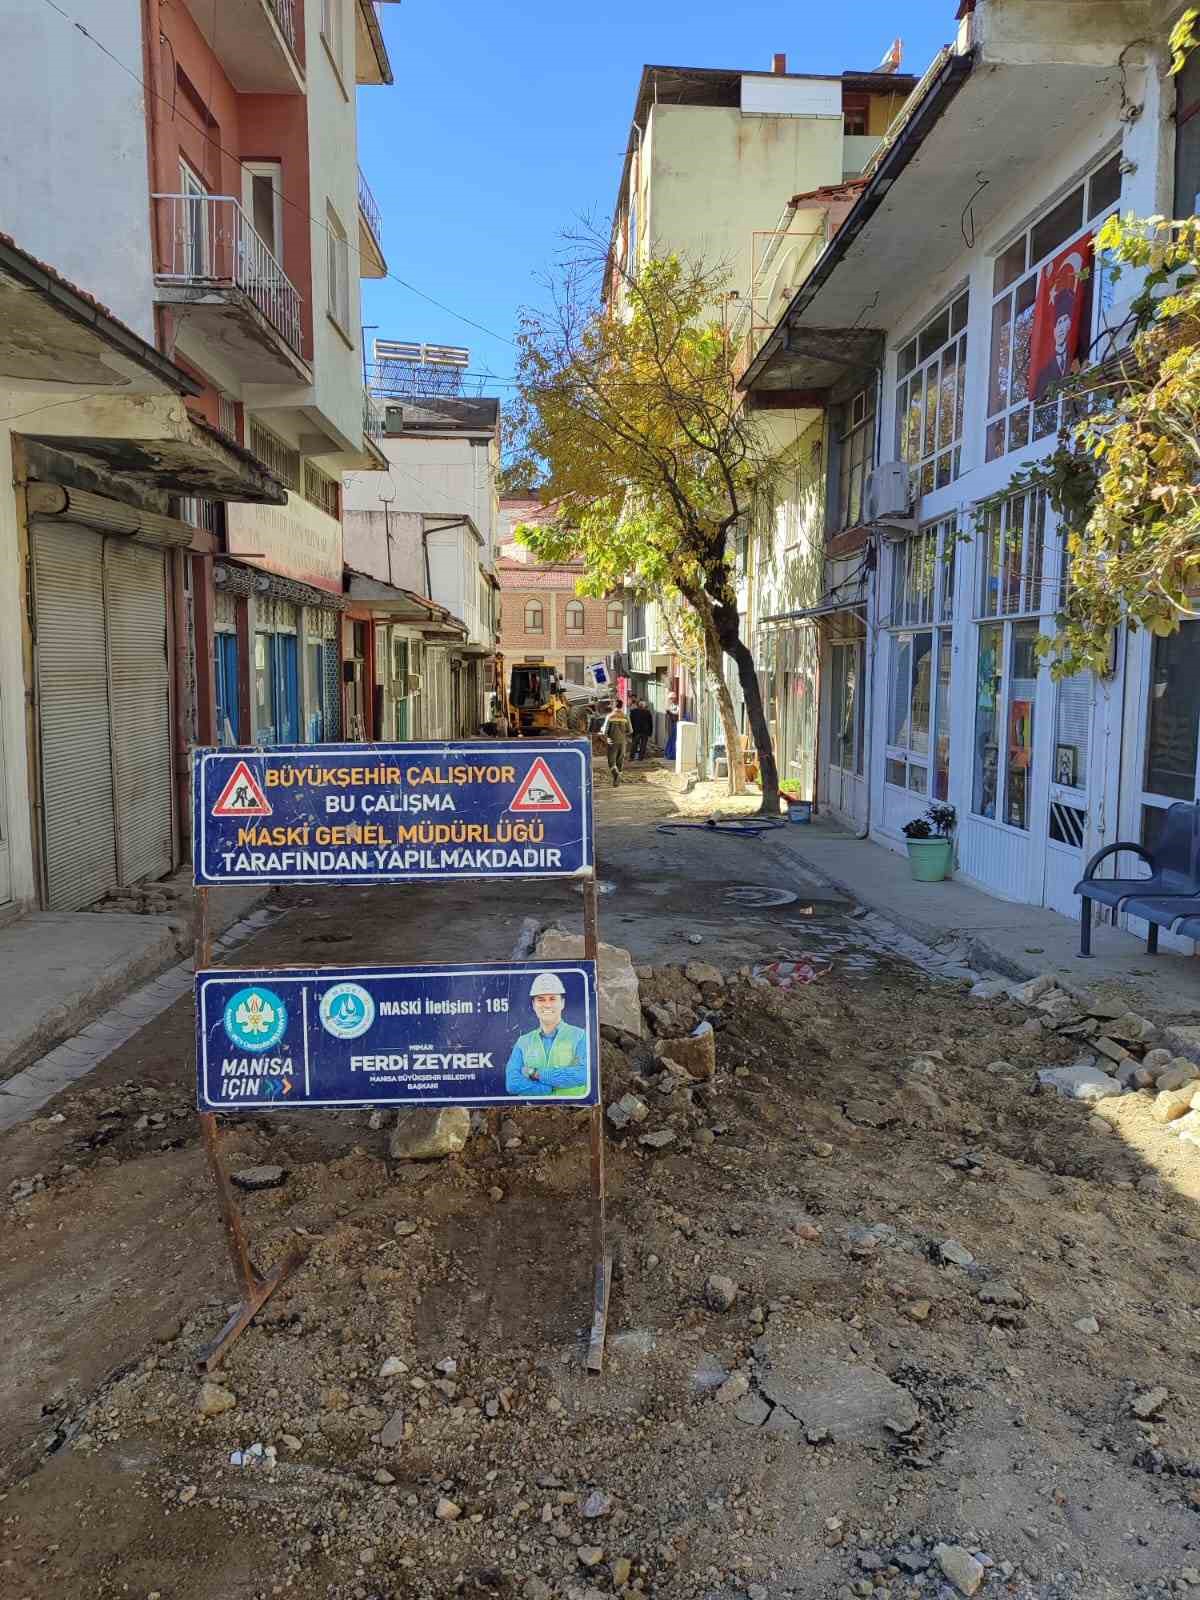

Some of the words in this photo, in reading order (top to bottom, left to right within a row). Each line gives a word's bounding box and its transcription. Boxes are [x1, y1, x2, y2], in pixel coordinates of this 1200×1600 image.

[265, 763, 400, 788] BÜYÜKŞEHİR
[406, 765, 516, 787] ÇALIŞIYOR
[325, 795, 355, 813] BU
[361, 794, 456, 815] ÇALIŞMA
[237, 822, 309, 847] MASKİ
[315, 825, 392, 845] GENEL
[399, 818, 544, 844] MÜDÜRLÜĞÜ
[222, 851, 368, 872] TARAFINDAN
[373, 848, 562, 869] YAPILMAKDADIR
[379, 998, 422, 1016] MASKİ
[412, 1052, 495, 1071] ZEYREK
